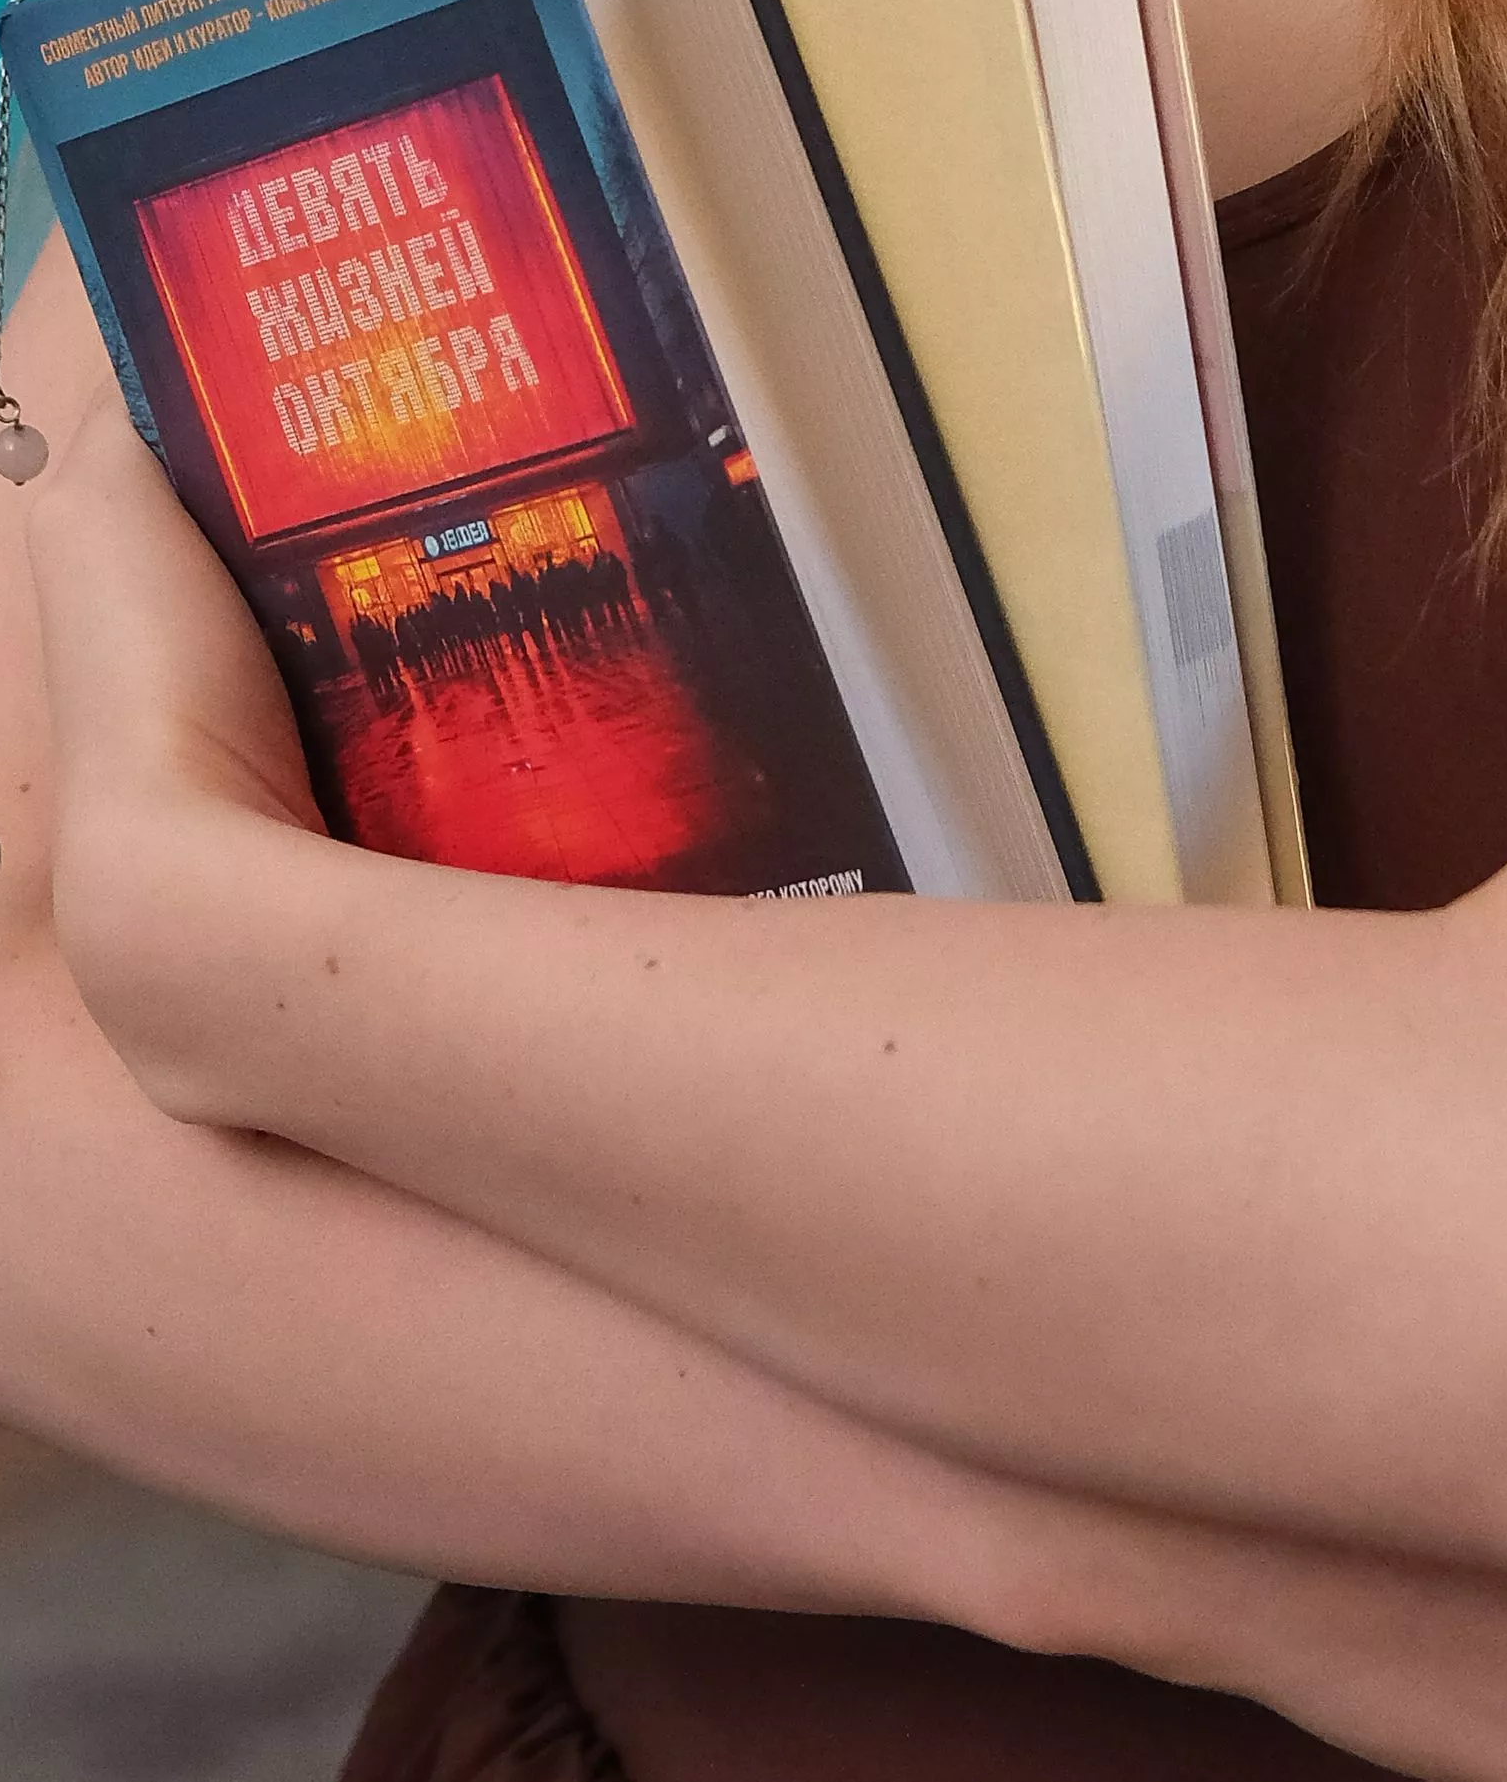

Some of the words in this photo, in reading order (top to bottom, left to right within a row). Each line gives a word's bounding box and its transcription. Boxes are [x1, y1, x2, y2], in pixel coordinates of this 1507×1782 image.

[40, 7, 140, 65] СОВМЕСТНЫЙ
[83, 53, 129, 88] АВТОР
[132, 37, 174, 71] ИДЕИ
[173, 33, 188, 54] И
[185, 8, 252, 50] КУРАТОР
[227, 134, 449, 267] ДЕВЯТЬ
[246, 208, 495, 362] ЖИЗНЕЙ
[272, 313, 540, 456] ОКТЯБРЯ
